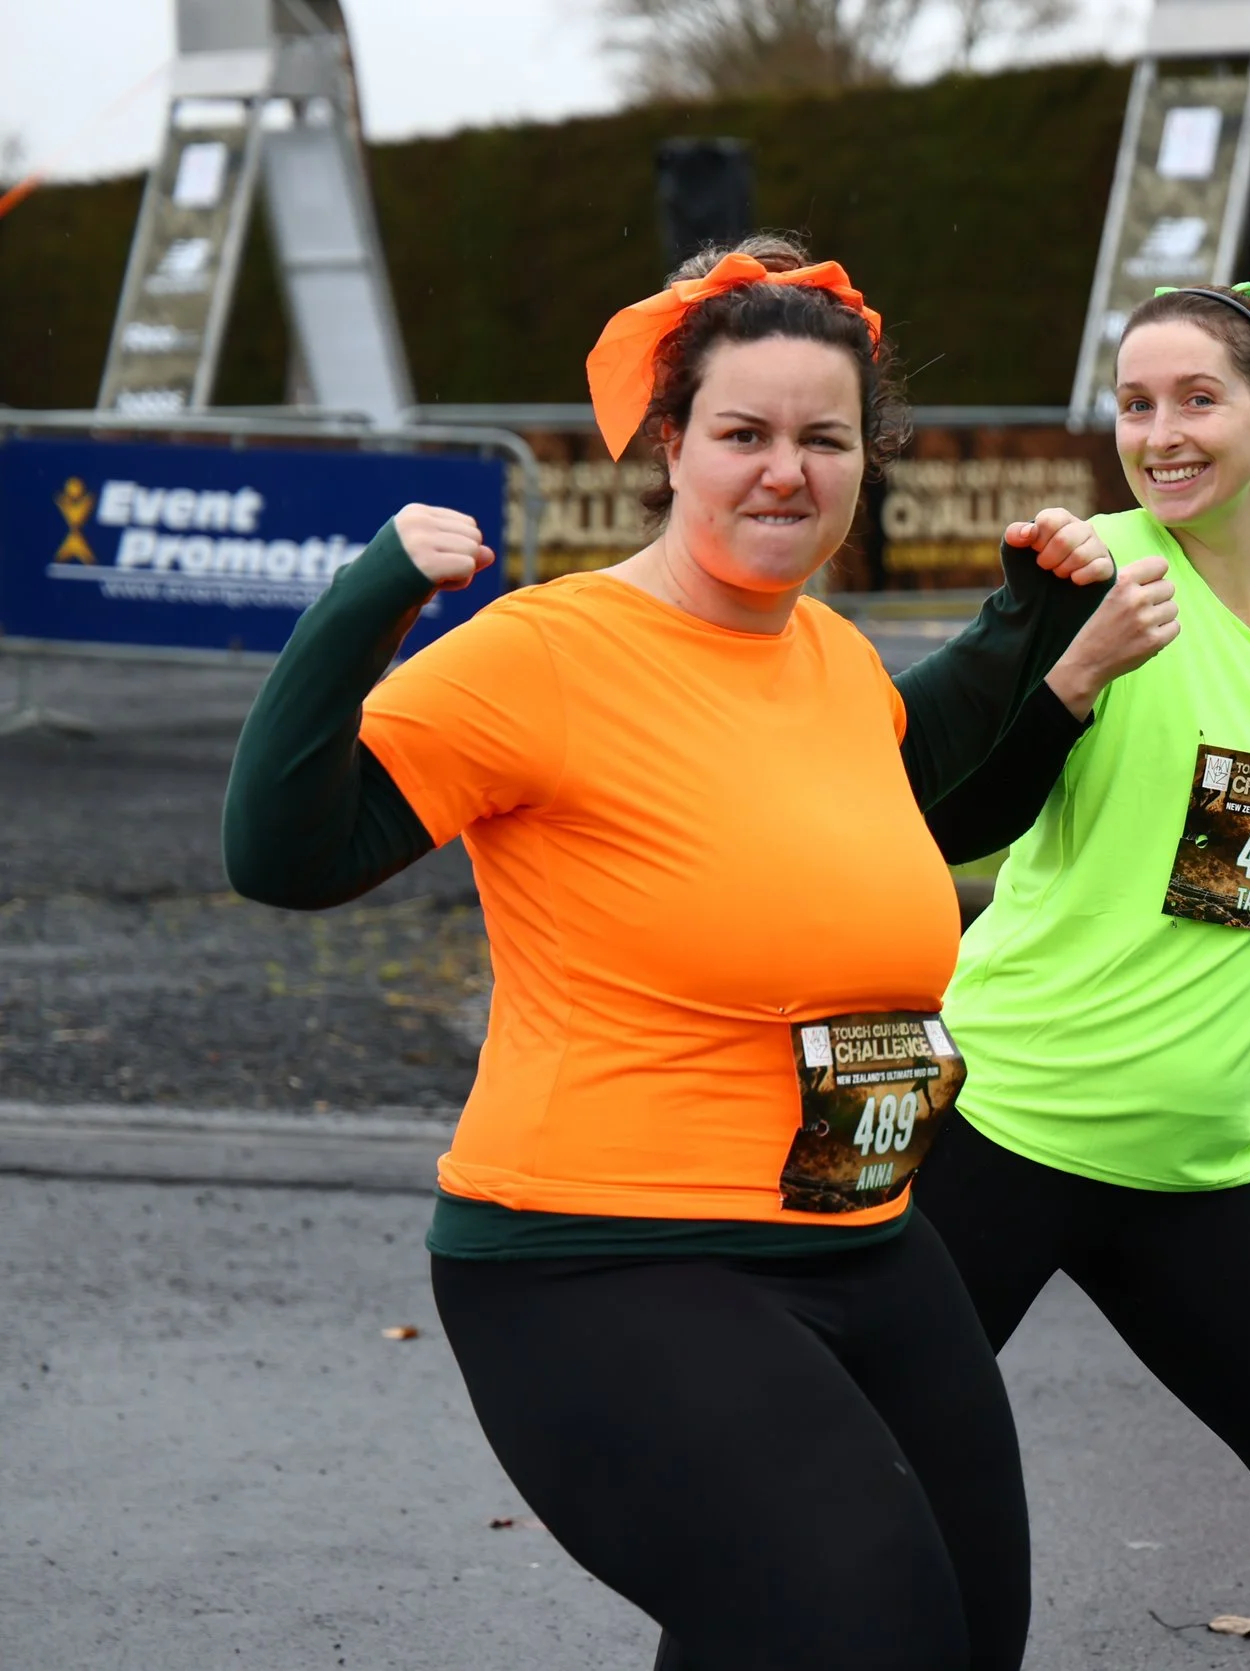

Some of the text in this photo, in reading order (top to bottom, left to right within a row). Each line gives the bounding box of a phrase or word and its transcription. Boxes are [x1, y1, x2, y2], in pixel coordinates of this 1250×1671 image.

[97, 480, 262, 532] Event
[117, 527, 368, 581] Promoti
[1226, 802, 1241, 812] NEW
[833, 1025, 871, 1041] TOUGH
[835, 1037, 933, 1064] CHALLENGE
[837, 1073, 852, 1086] NEW
[852, 1070, 885, 1084] ZEALAND'S
[886, 1068, 914, 1082] ULTIMATE
[853, 1091, 918, 1157] 489
[856, 1162, 894, 1191] ANNA
